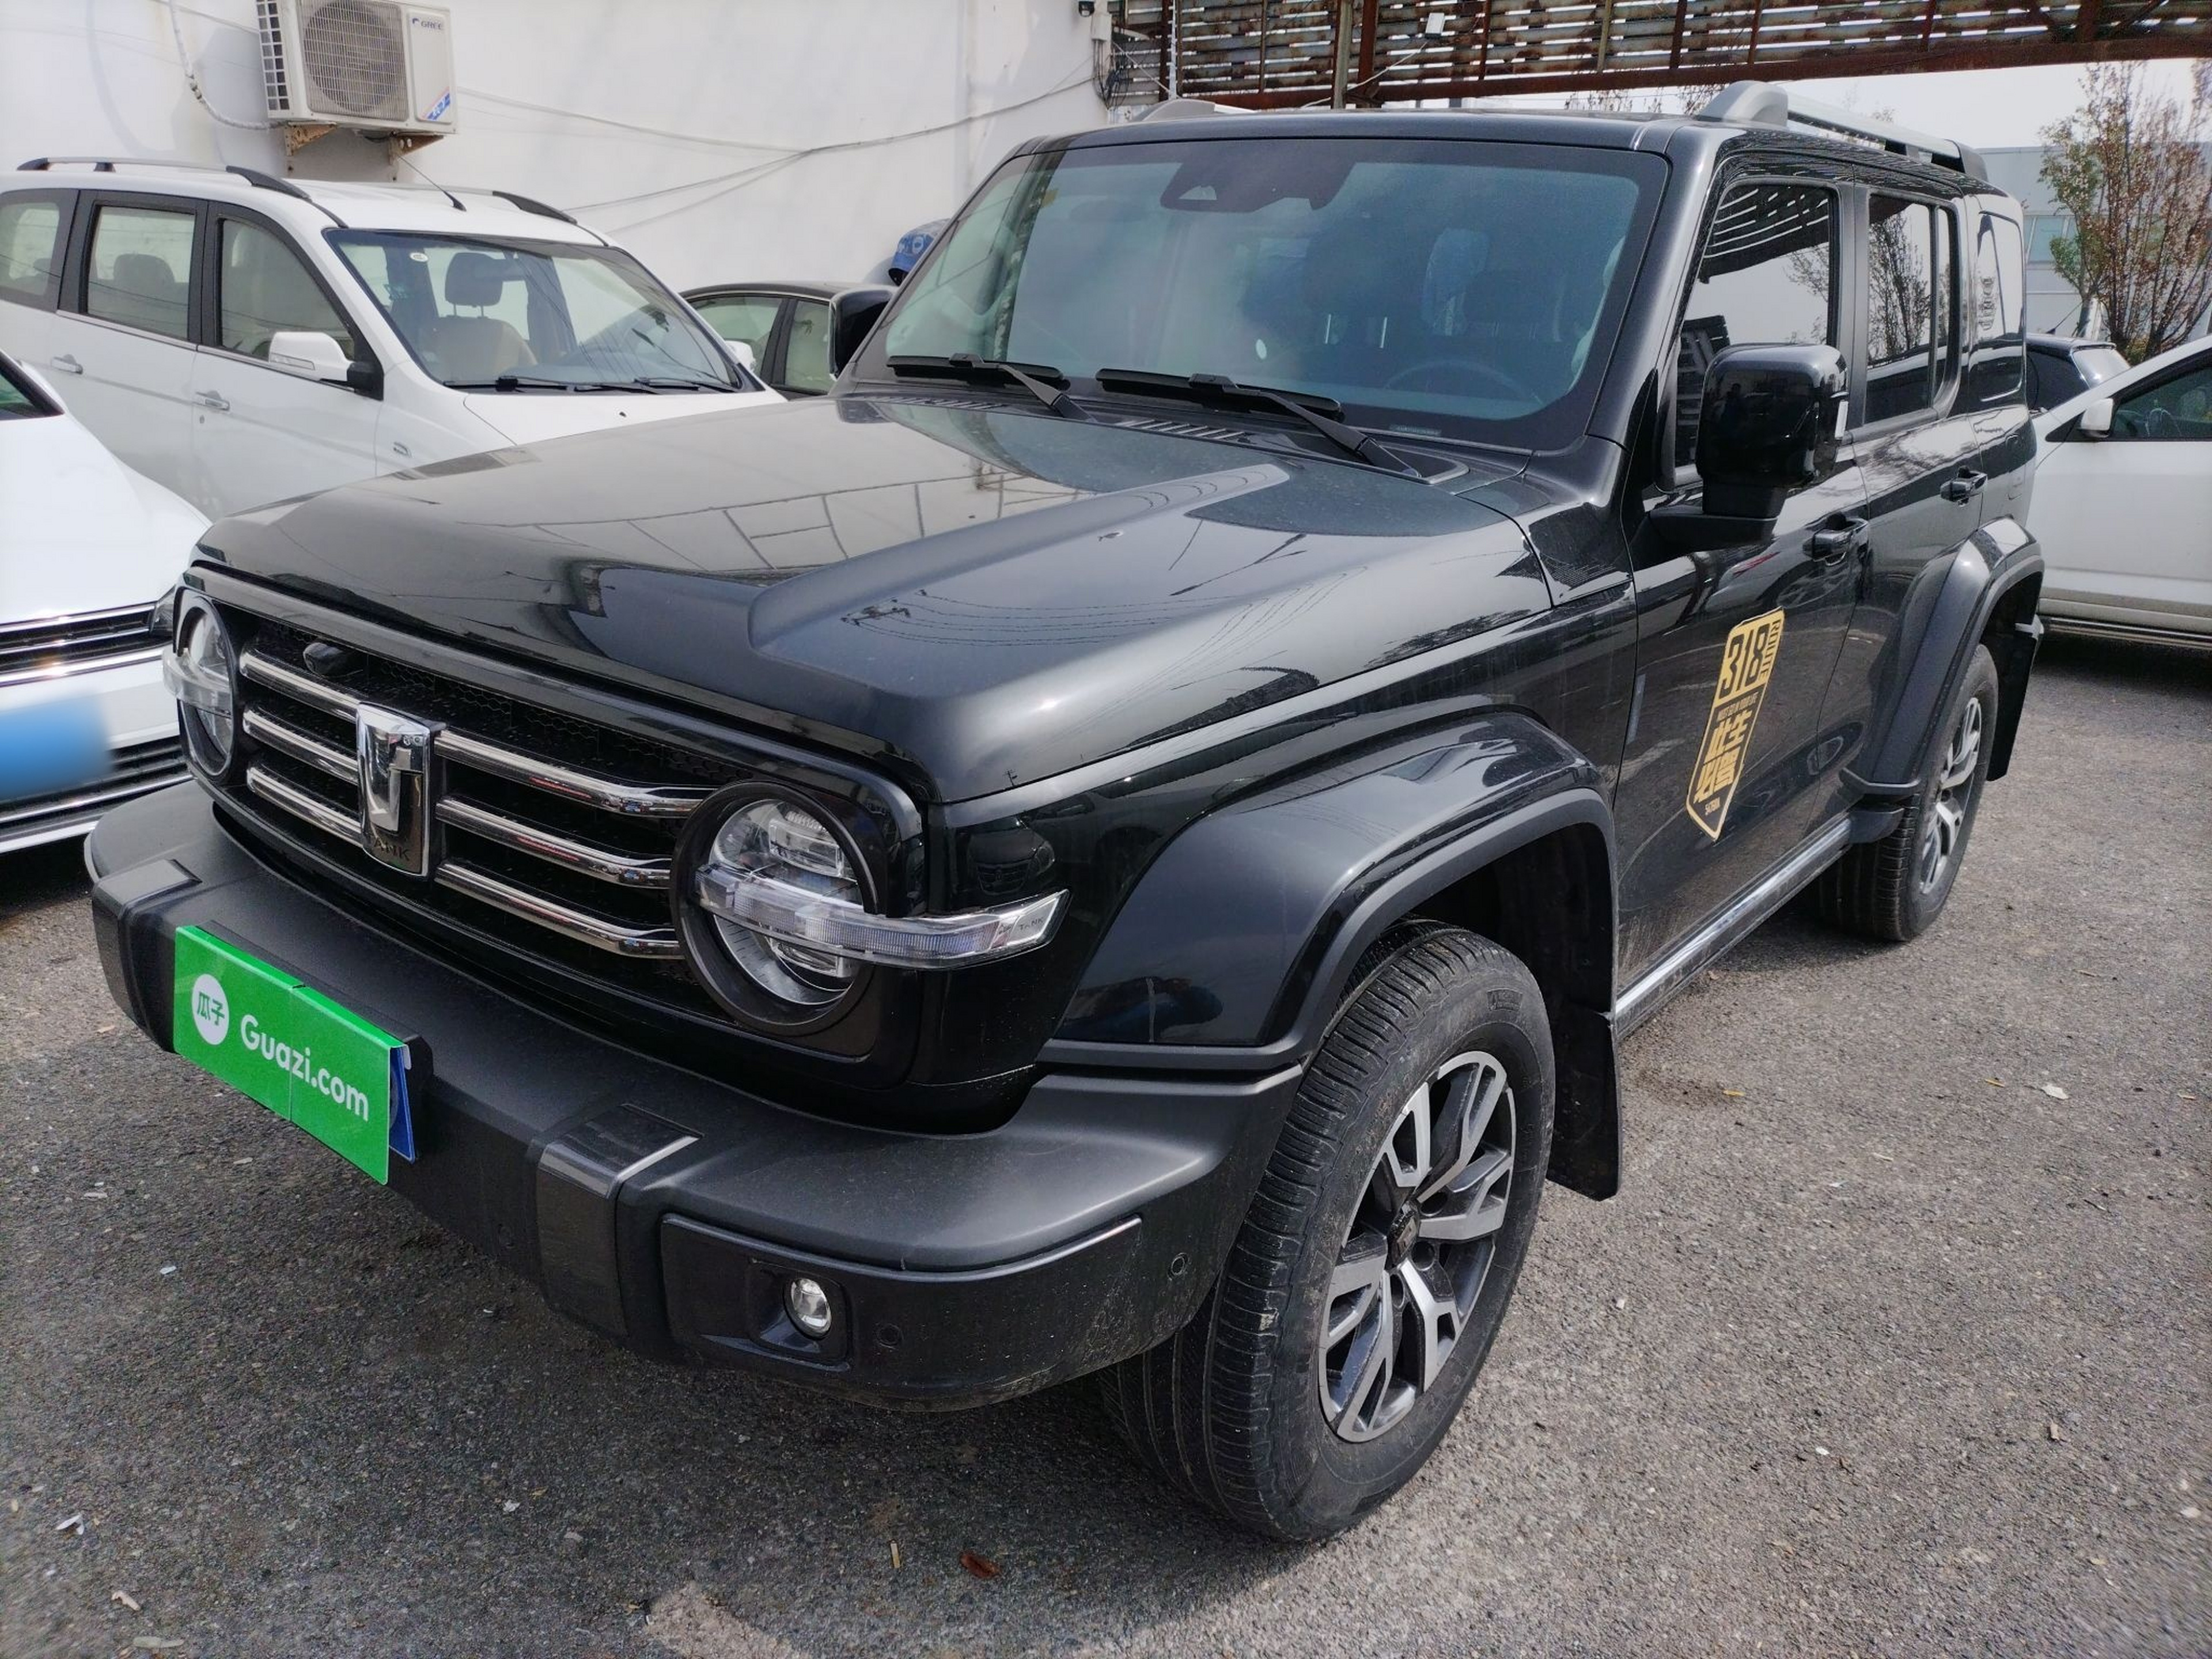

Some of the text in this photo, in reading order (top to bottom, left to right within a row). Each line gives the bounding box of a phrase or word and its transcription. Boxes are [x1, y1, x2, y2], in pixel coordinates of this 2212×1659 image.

[1719, 623, 1770, 699] 318
[1758, 619, 1781, 680] ROUTE
[197, 991, 225, 1026] 瓜子
[241, 1014, 369, 1122] Guazi.com
